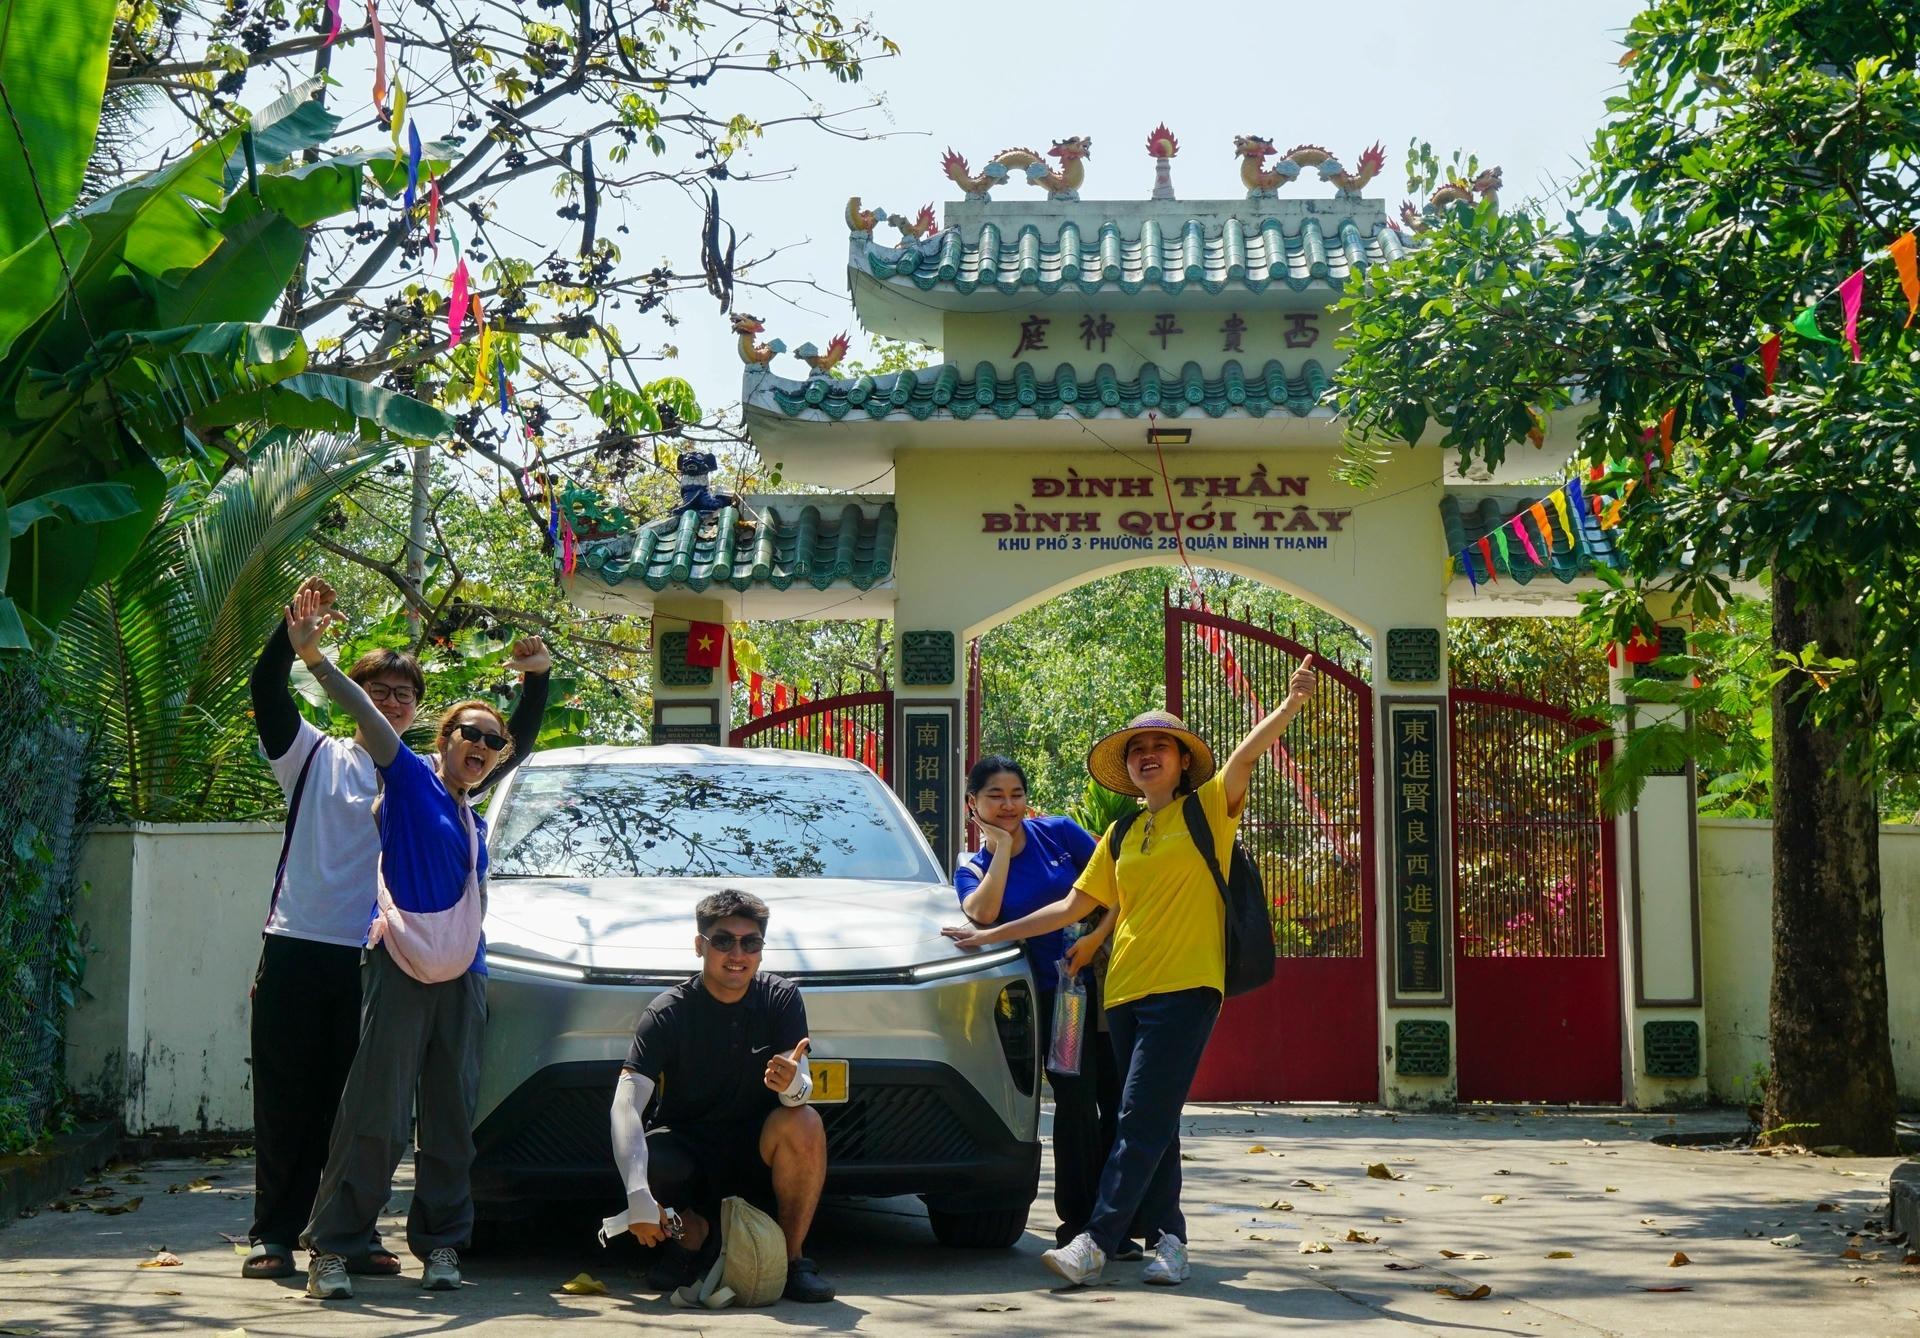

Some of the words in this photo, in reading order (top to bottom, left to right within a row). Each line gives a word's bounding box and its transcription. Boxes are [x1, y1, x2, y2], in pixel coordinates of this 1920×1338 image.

[1031, 467, 1154, 497] ĐÌNH
[1173, 463, 1309, 497] THẦN
[981, 503, 1101, 532] BÌNH
[1118, 501, 1237, 536] QUỚI
[1253, 505, 1351, 532] TÂY
[998, 537, 1031, 550] KHU
[1036, 533, 1069, 550] PHỐ
[1072, 537, 1081, 550] 3
[1090, 533, 1154, 550] PHƯỜNG
[1158, 536, 1178, 550] 28
[1185, 533, 1228, 552] QUẬN
[1232, 532, 1269, 550] BÌNH
[1274, 536, 1328, 552] THẠNH
